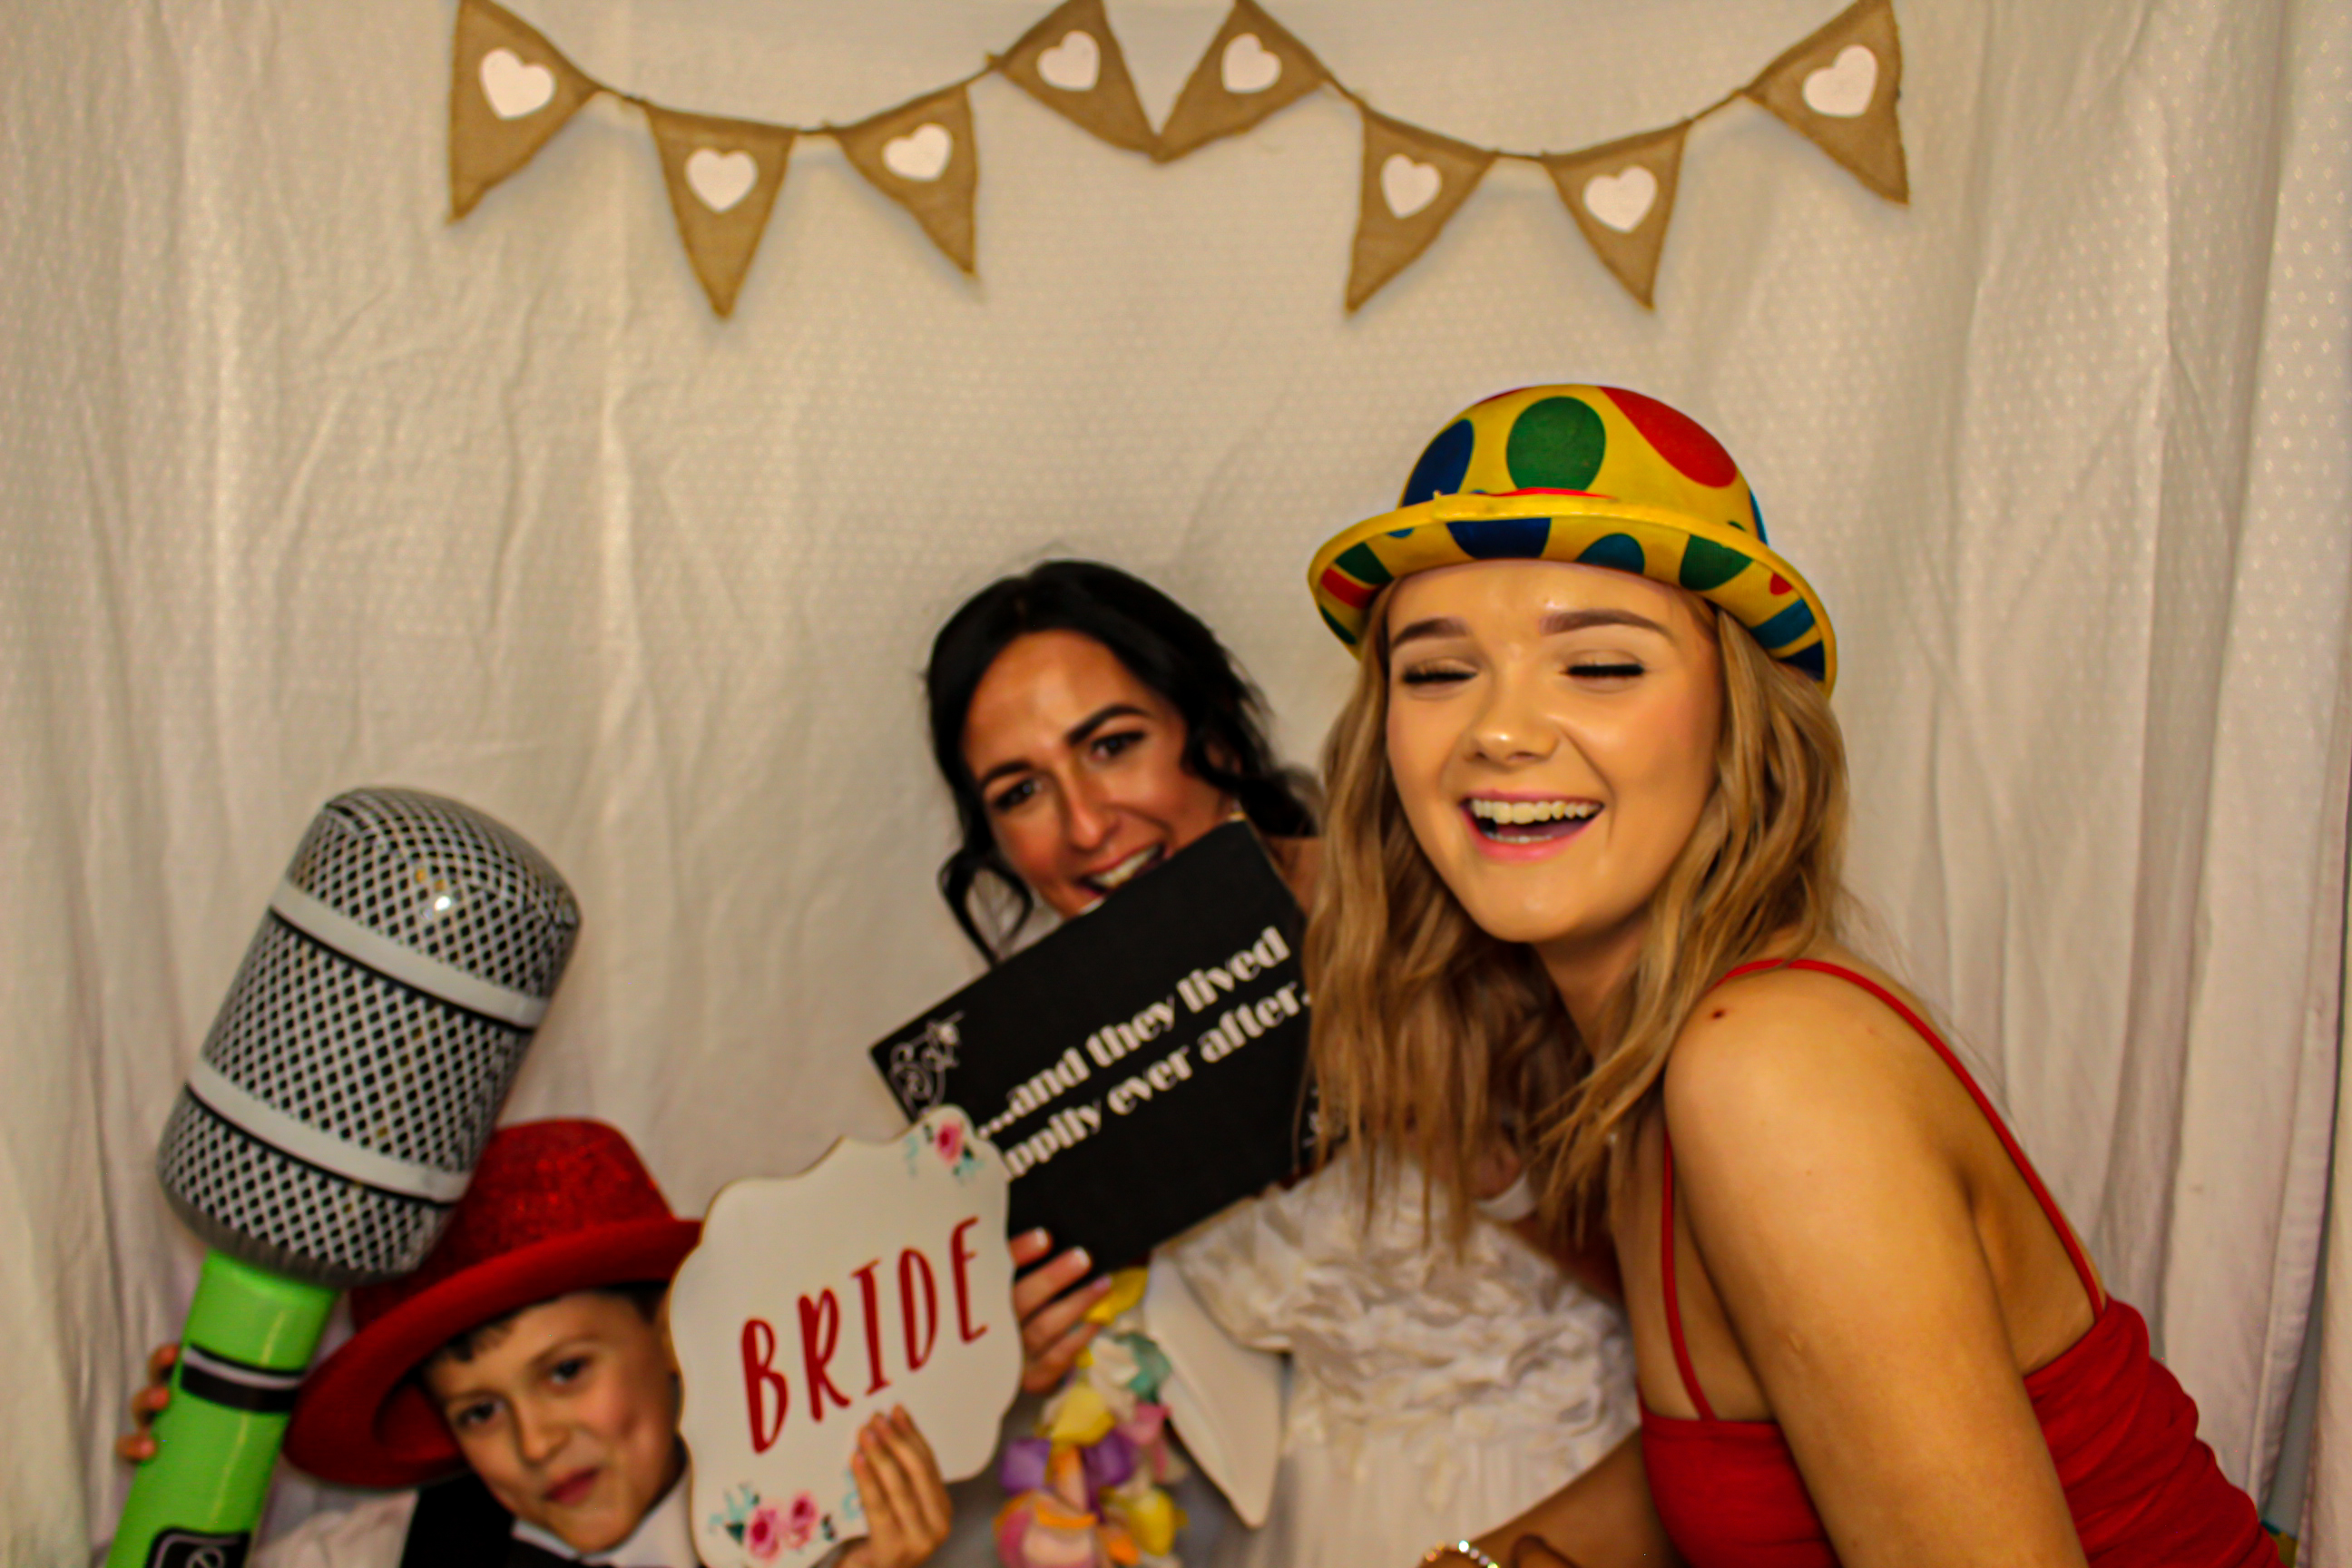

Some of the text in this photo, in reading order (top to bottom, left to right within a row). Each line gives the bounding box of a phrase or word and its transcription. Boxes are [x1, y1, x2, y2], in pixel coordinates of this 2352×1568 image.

[977, 925, 1290, 1141] ...and they lived
[1004, 1098, 1102, 1178] ppily
[1106, 1044, 1193, 1116] ever
[740, 1215, 988, 1455] BRIDE
